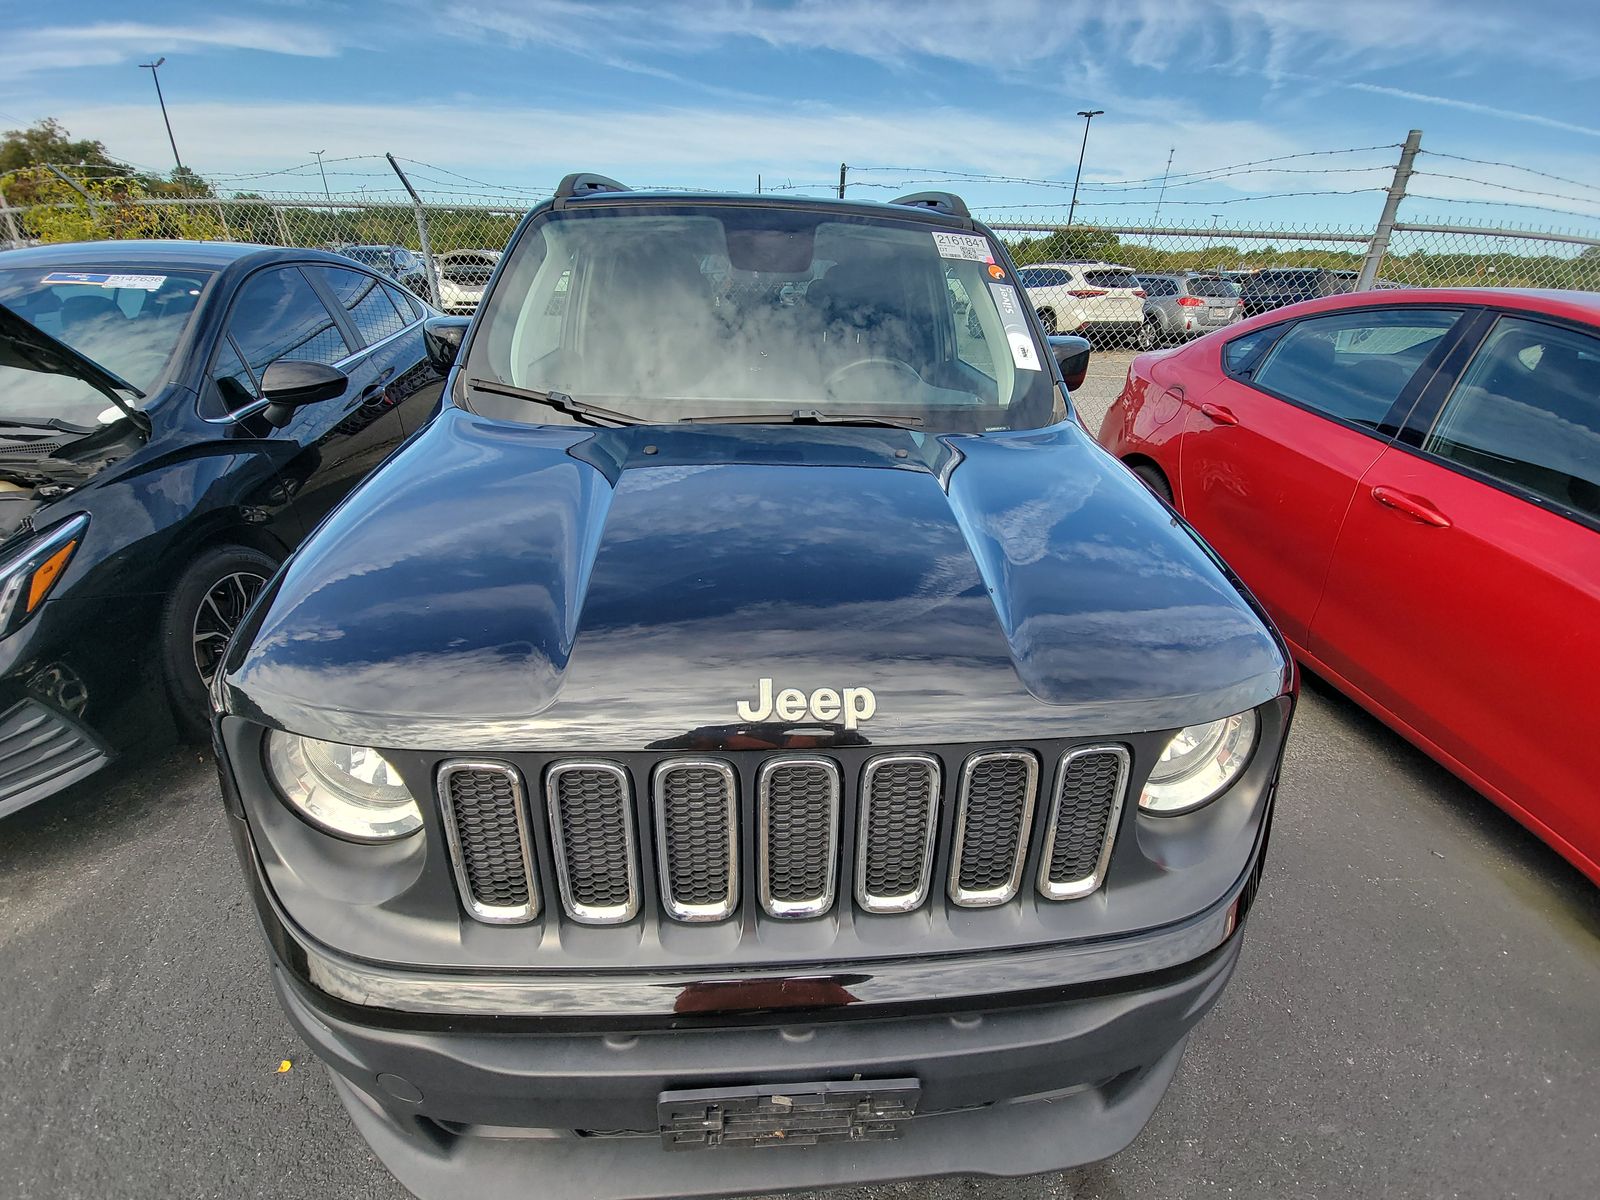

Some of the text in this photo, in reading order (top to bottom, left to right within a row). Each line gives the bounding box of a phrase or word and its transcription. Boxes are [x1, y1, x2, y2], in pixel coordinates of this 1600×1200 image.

[937, 235, 985, 249] 2161841
[1000, 287, 1014, 314] Silver
[736, 678, 876, 730] Jeep
